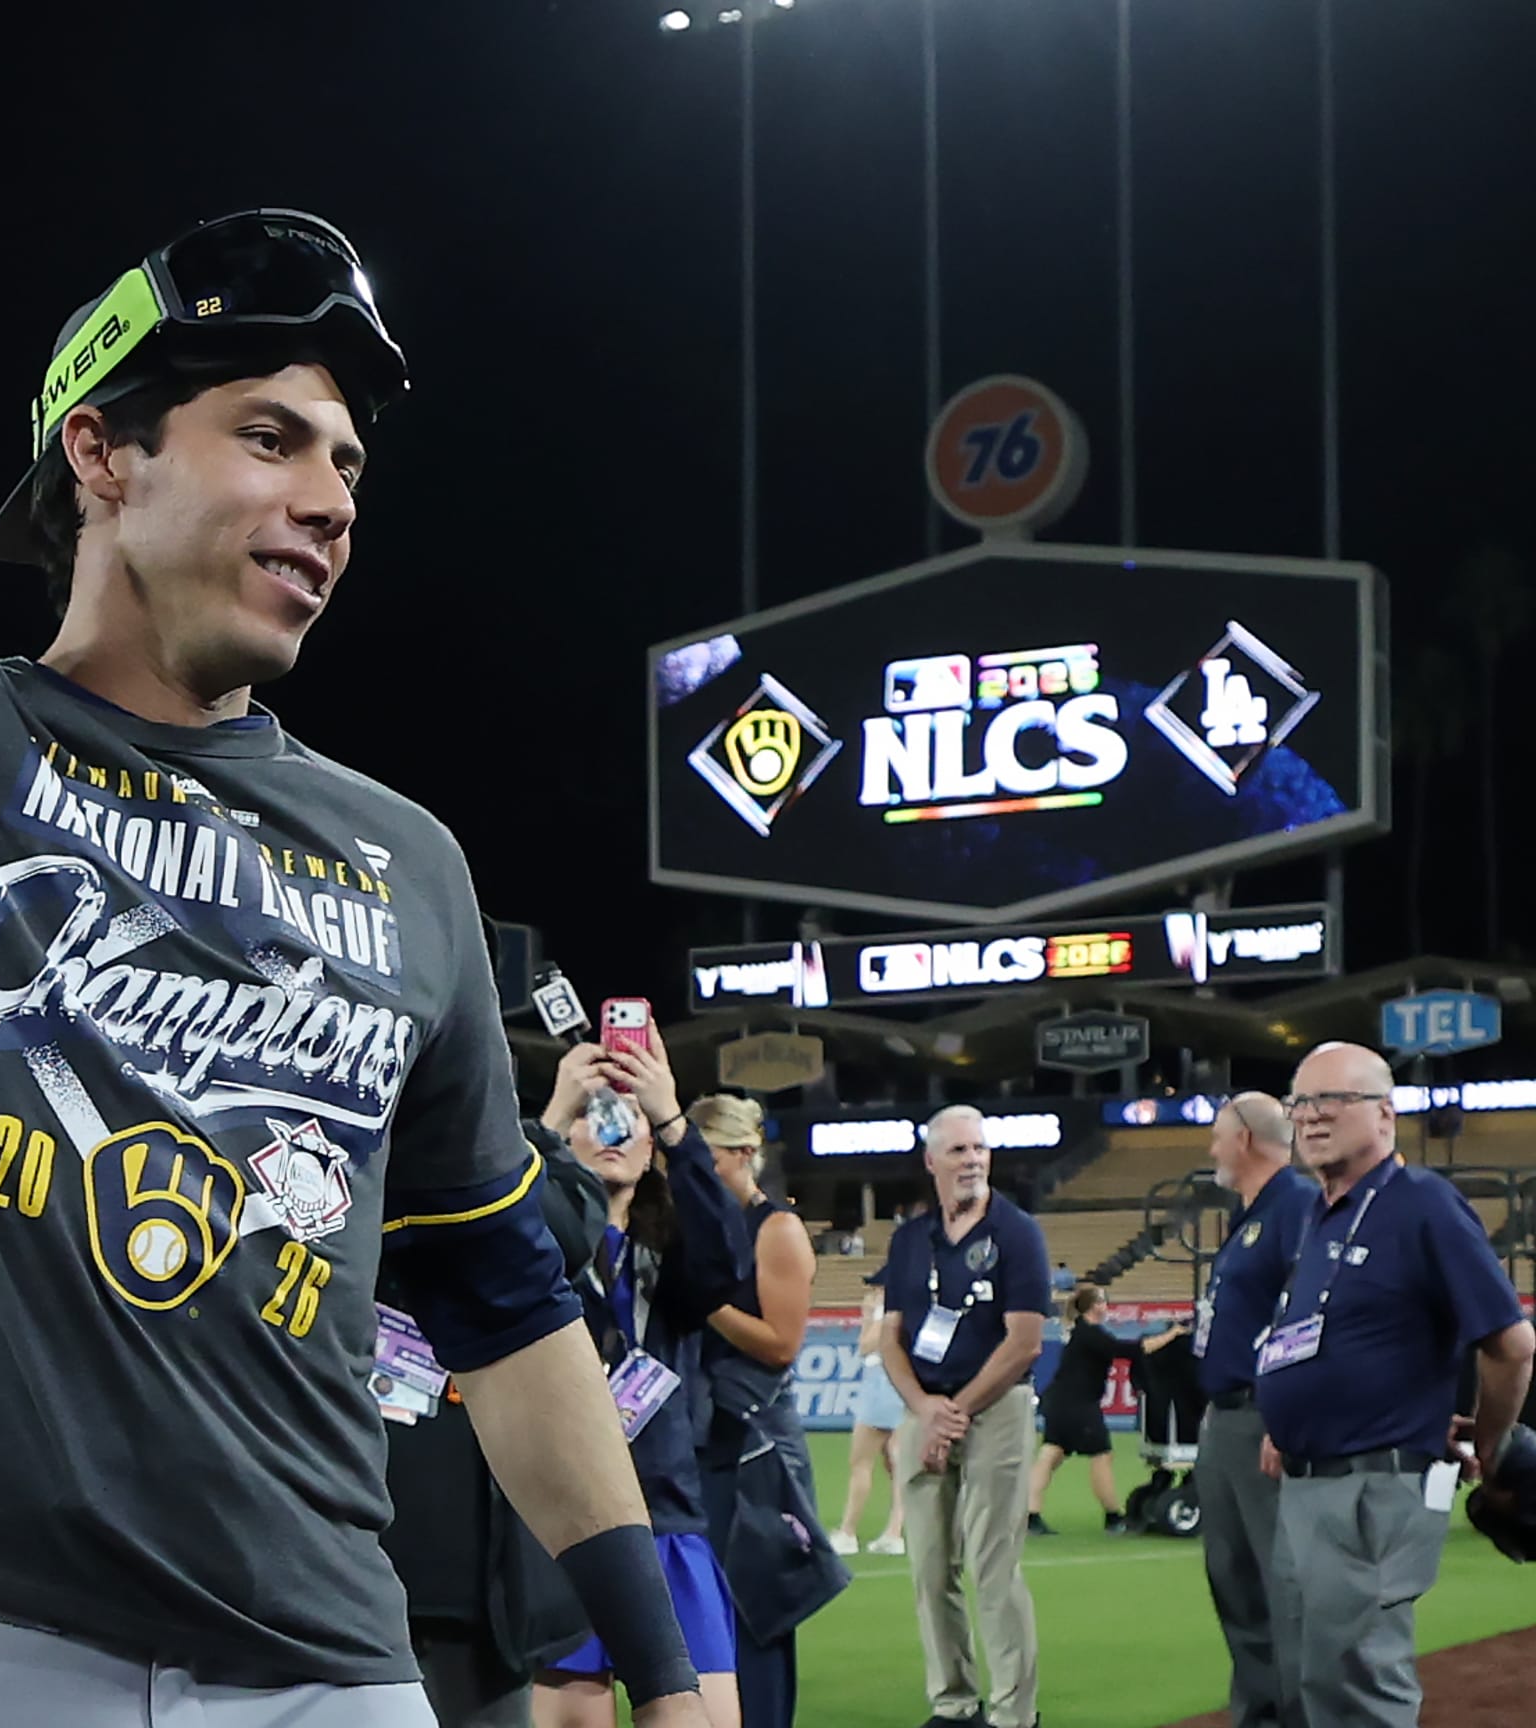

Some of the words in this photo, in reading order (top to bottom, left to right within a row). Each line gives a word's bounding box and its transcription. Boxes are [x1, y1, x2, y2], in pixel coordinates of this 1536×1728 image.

[196, 296, 223, 317] 22
[961, 411, 1041, 484] 76
[858, 693, 1128, 804] NLCS
[932, 936, 1046, 986] NLCS
[549, 998, 572, 1020] 6
[1393, 1000, 1488, 1042] TEL
[260, 1240, 333, 1339] 26
